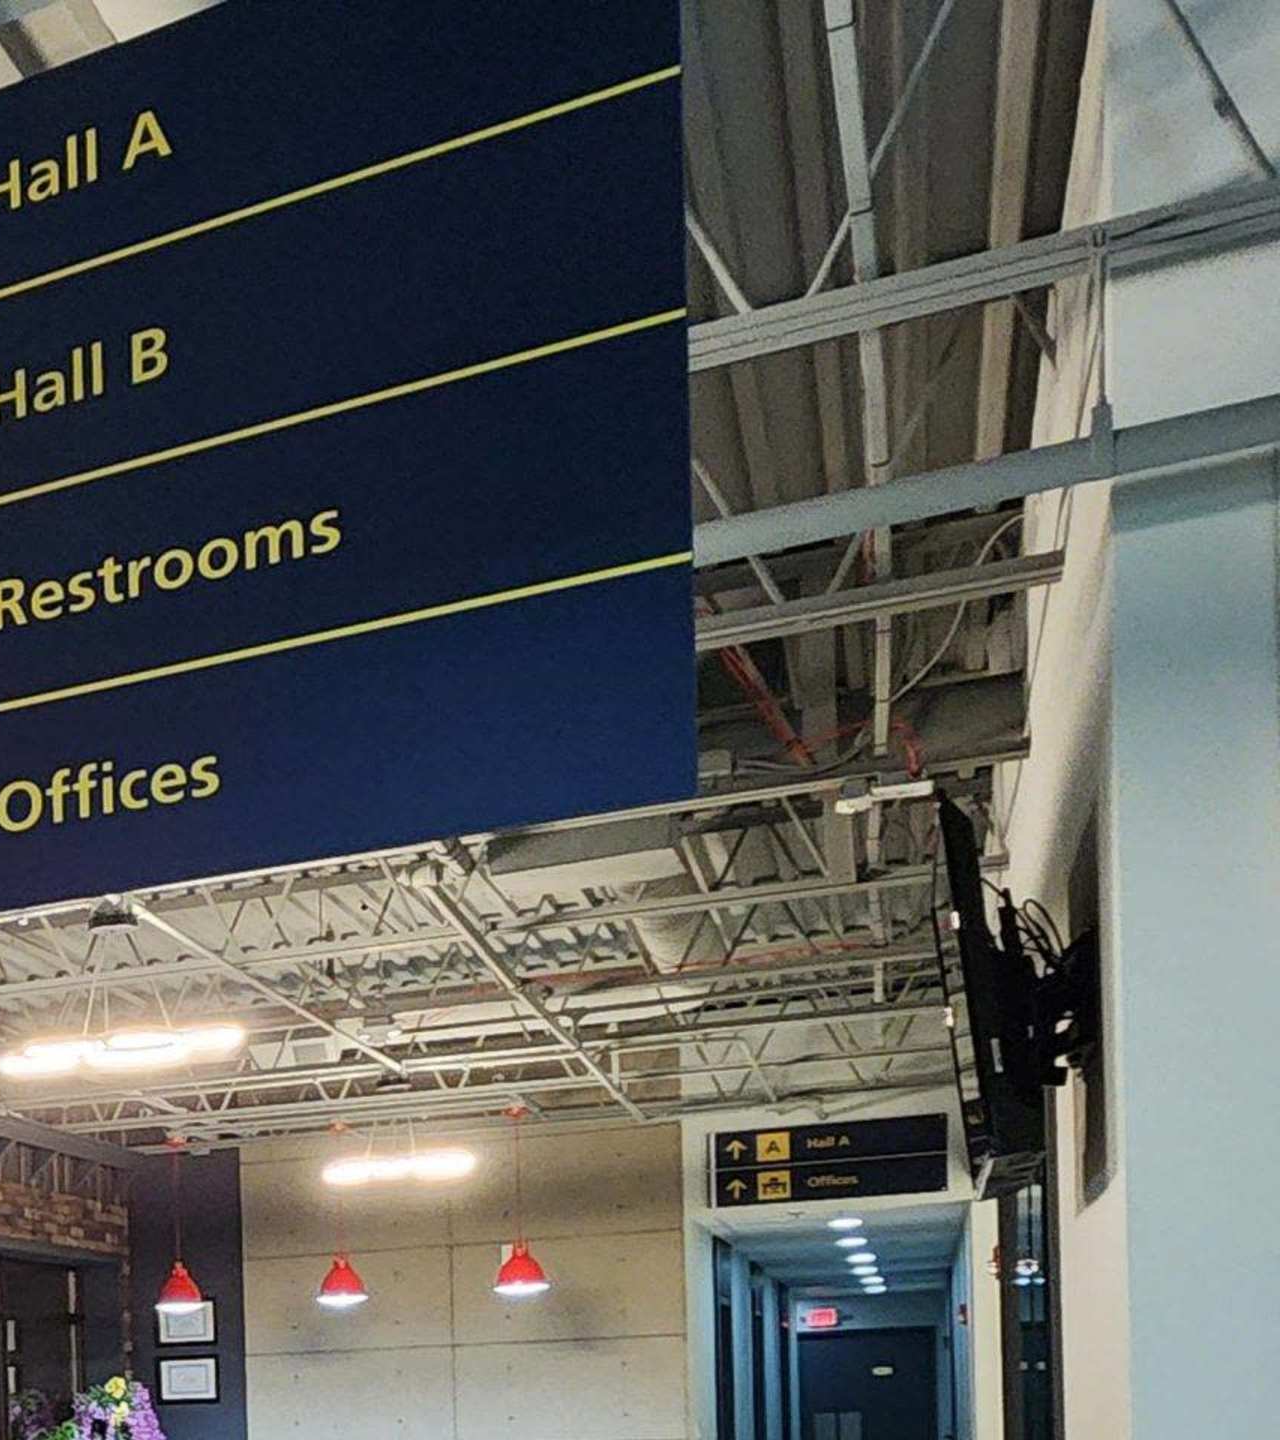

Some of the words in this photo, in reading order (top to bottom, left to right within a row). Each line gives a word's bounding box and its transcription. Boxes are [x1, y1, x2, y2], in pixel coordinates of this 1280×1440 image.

[122, 110, 172, 170] A
[131, 327, 168, 384] B
[766, 1140, 780, 1154] A
[806, 1136, 835, 1149] Hall
[839, 1136, 850, 1147] A
[807, 1174, 859, 1188] Offices
